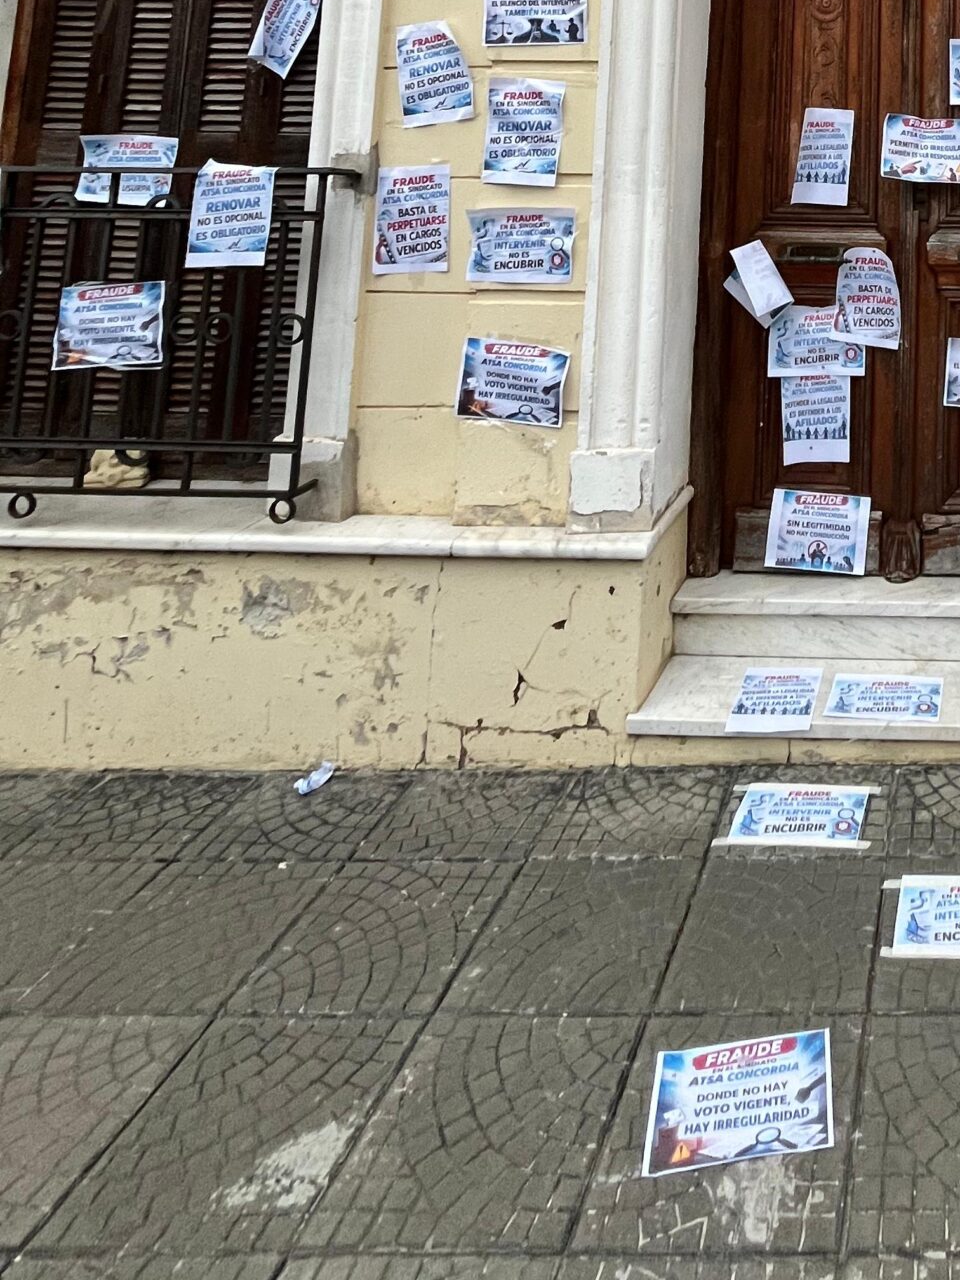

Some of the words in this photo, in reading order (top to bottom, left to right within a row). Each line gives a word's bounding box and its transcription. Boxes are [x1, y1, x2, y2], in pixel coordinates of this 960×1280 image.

[409, 58, 461, 78] RENOVAR
[405, 83, 415, 91] NO
[406, 96, 415, 104] ES
[418, 82, 469, 101] OBLIGATORIO
[504, 92, 543, 100] FRAUDE
[498, 121, 551, 131] RENOVAR
[807, 121, 835, 129] FRAUDE
[909, 120, 948, 129] FRAUDE
[501, 148, 556, 158] OBLIGATORIO
[800, 162, 838, 170] AFILIADOS
[212, 170, 253, 180] FRAUDE
[226, 177, 259, 185] SINDICATO
[393, 175, 435, 187] FRAUDE
[223, 184, 266, 194] CONCORDIA
[408, 183, 442, 193] SINDICATO
[404, 190, 448, 203] CONCORDIA
[206, 198, 260, 213] RENOVAR
[398, 206, 426, 217] BASTA
[197, 218, 211, 226] NO
[387, 215, 447, 232] PERPETUARSE
[211, 225, 266, 239] OBLIGATORIO
[396, 233, 407, 243] EN
[409, 228, 441, 241] CARGOS
[397, 240, 442, 255] VENCIDOS
[494, 240, 545, 250] INTERVENIR
[494, 260, 544, 270] ENCUBRIR
[85, 286, 134, 299] FRAUDE
[858, 284, 882, 294] BASTA
[865, 306, 895, 316] CARGOS
[853, 317, 895, 327] VENCIDOS
[492, 345, 541, 355] FRAUDE
[794, 354, 839, 365] ENCUBRIR
[481, 359, 501, 367] ATSA
[504, 361, 547, 373] CONCORDIA
[487, 371, 509, 380] DONDE
[507, 384, 539, 394] VIGENTE,
[495, 392, 550, 405] IRREGULARIDAD
[795, 416, 838, 427] AFILIADOS
[800, 495, 843, 505] FRAUDE
[787, 520, 800, 529] SIN
[802, 521, 851, 532] LEGITIMIDAD
[764, 823, 827, 833] ENCUBRIR
[936, 899, 959, 907] ATSA
[704, 1039, 783, 1067] FRAUDE
[689, 1075, 723, 1086] ATSA
[727, 1062, 799, 1081] CONCORDIA
[697, 1089, 739, 1102] DONDE
[743, 1086, 760, 1095] NO
[763, 1081, 788, 1093] HAY
[694, 1104, 730, 1118] VOTO
[734, 1095, 791, 1111] VIGENTE,
[684, 1122, 710, 1135] HAY
[713, 1107, 810, 1130] IRREGULARIDAD
